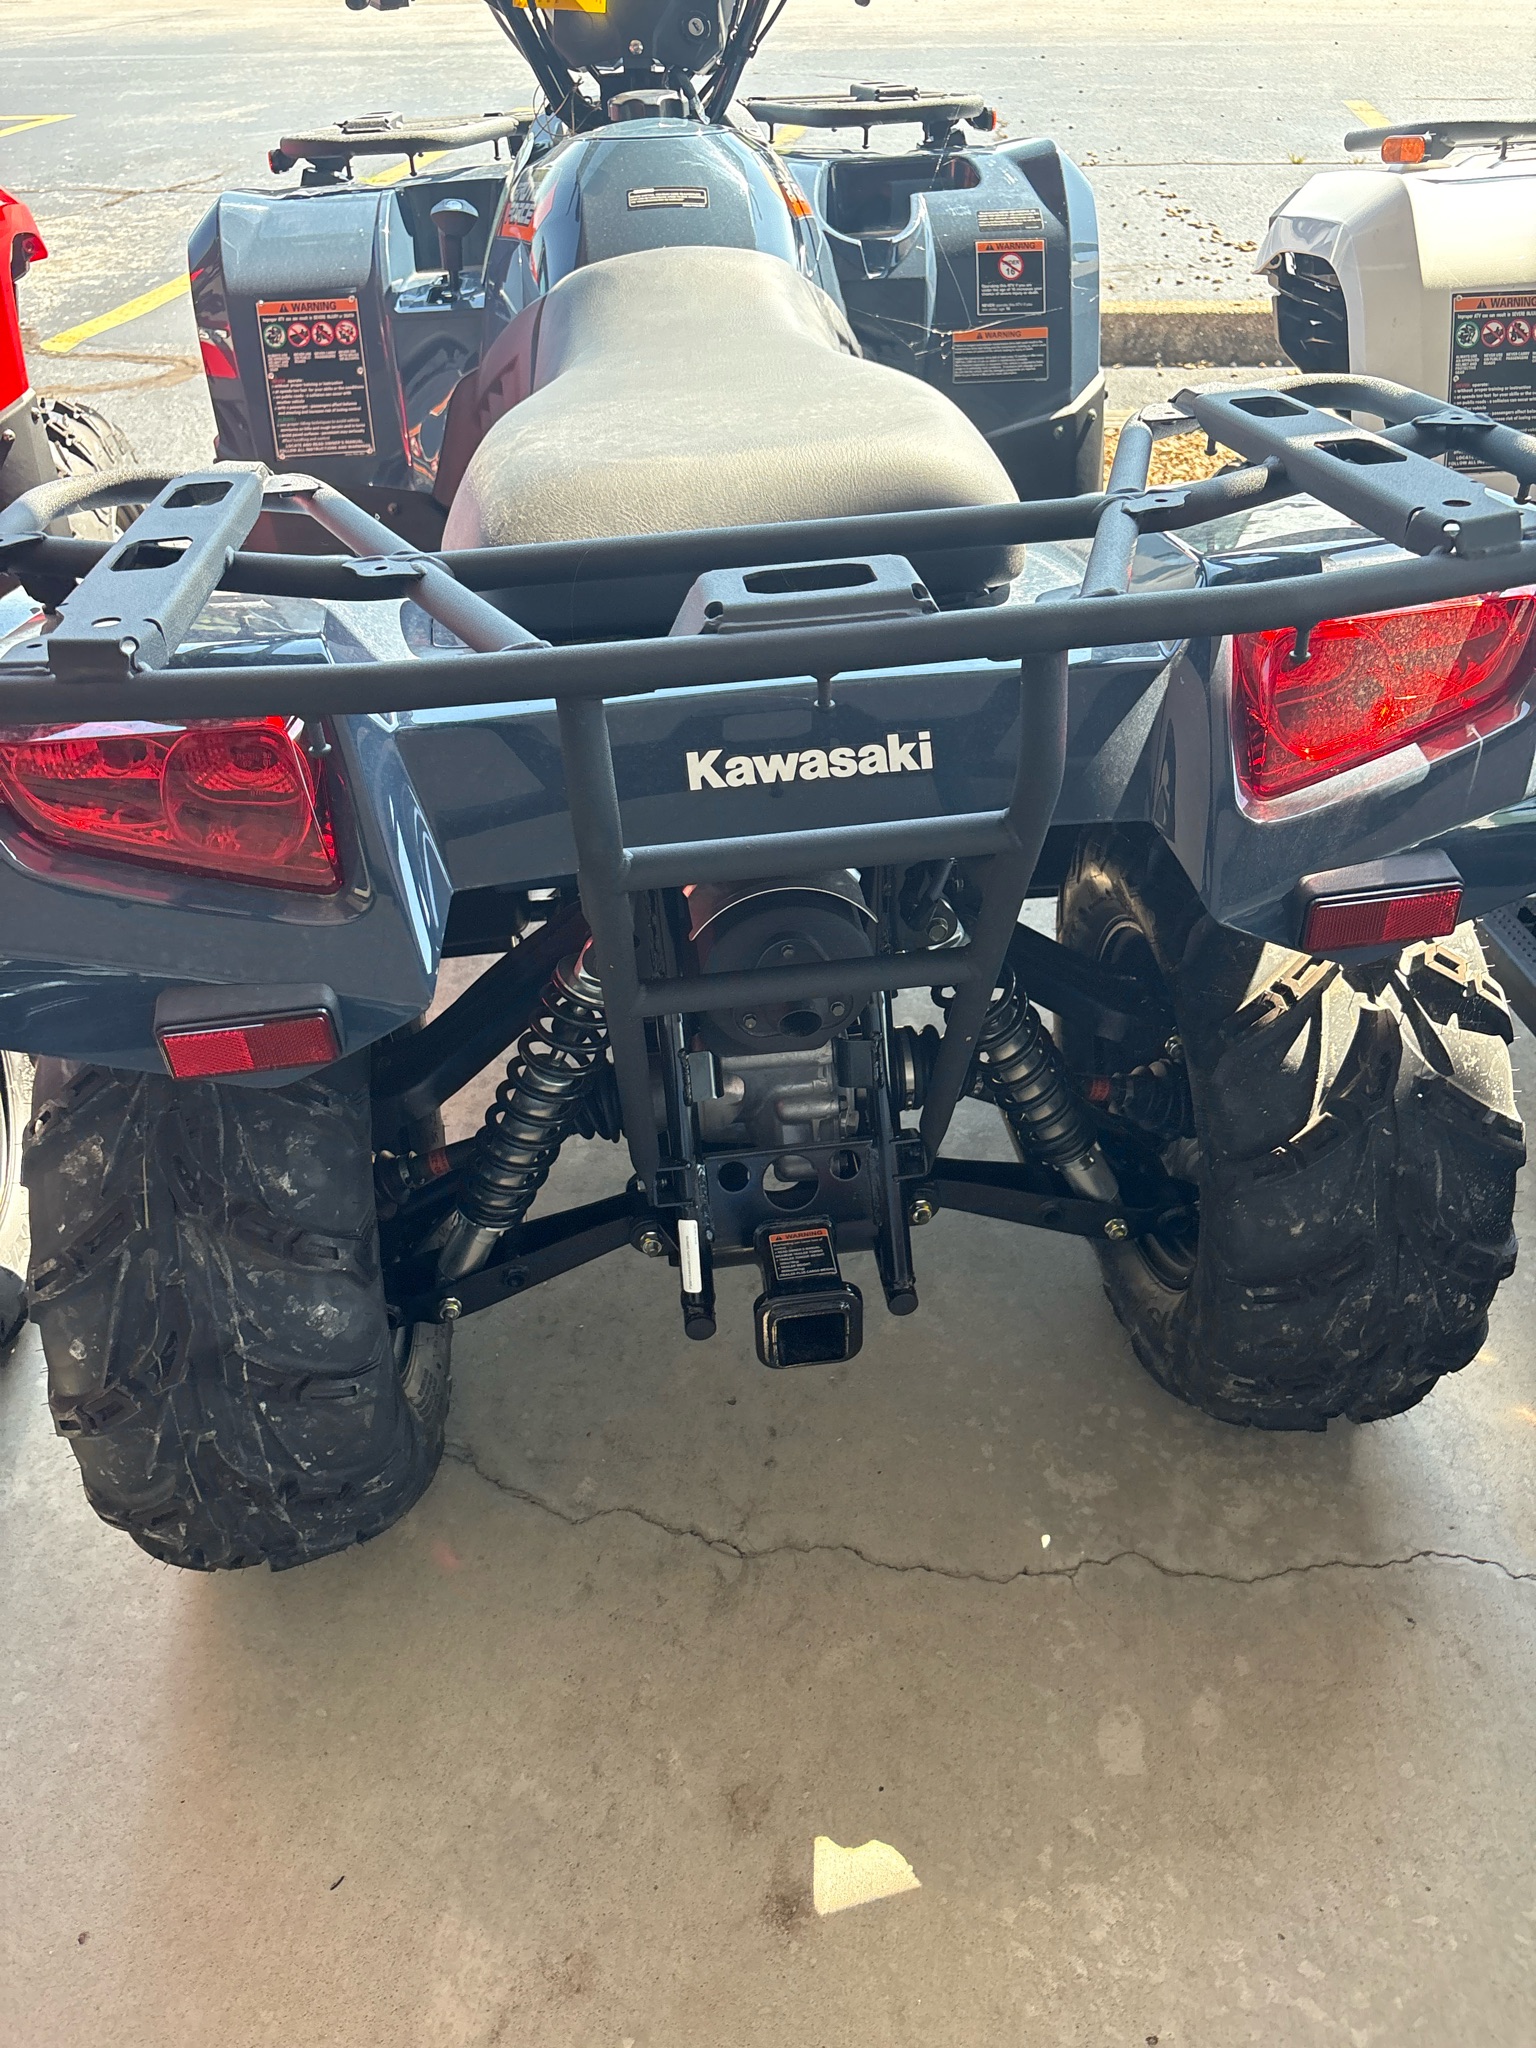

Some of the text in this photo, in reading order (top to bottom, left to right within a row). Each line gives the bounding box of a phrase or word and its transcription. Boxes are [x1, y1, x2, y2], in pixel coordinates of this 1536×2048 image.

[996, 242, 1035, 250] WARNING
[1491, 296, 1536, 308] WARNING
[291, 302, 337, 312] WARNING
[985, 331, 1021, 339] WARNING
[685, 730, 933, 791] Kawasaki
[785, 1231, 823, 1239] WARNING
